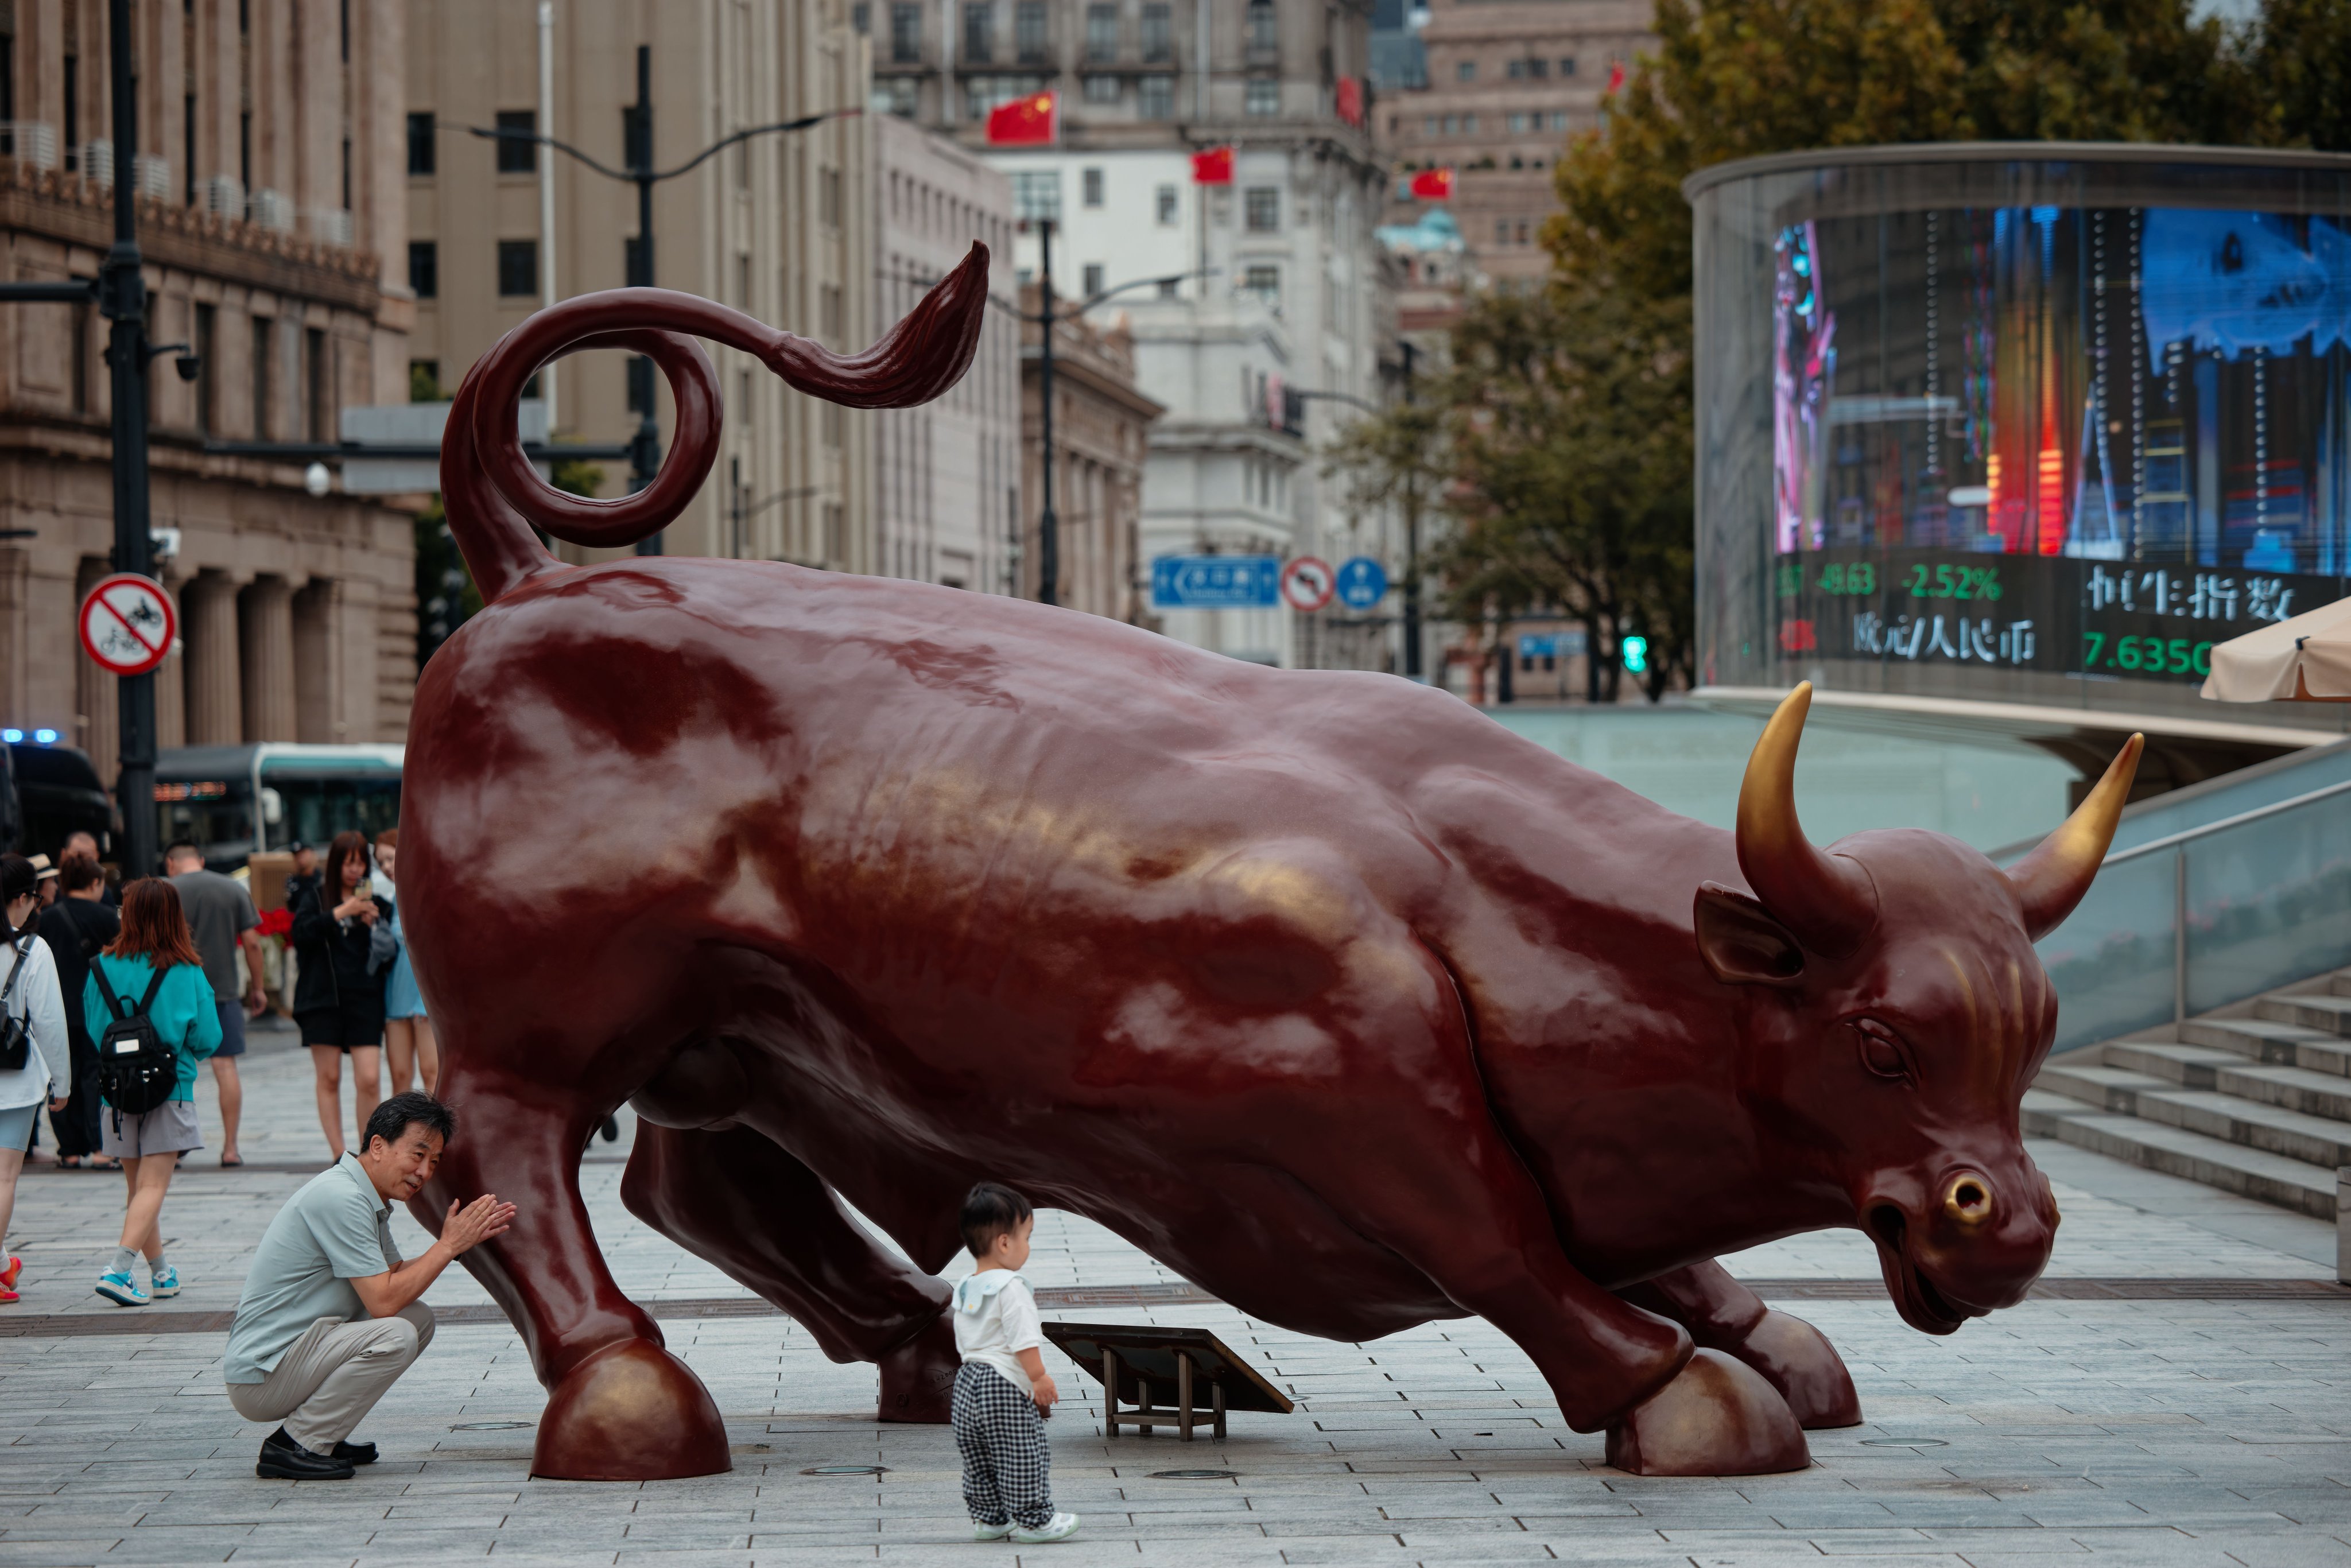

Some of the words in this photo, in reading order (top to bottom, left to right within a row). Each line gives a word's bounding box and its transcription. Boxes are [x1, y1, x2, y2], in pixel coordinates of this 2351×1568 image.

[1901, 563, 2003, 601] -2.52%
[2082, 564, 2296, 622] 恒生指数
[1853, 611, 2035, 664] 欧元/人民币
